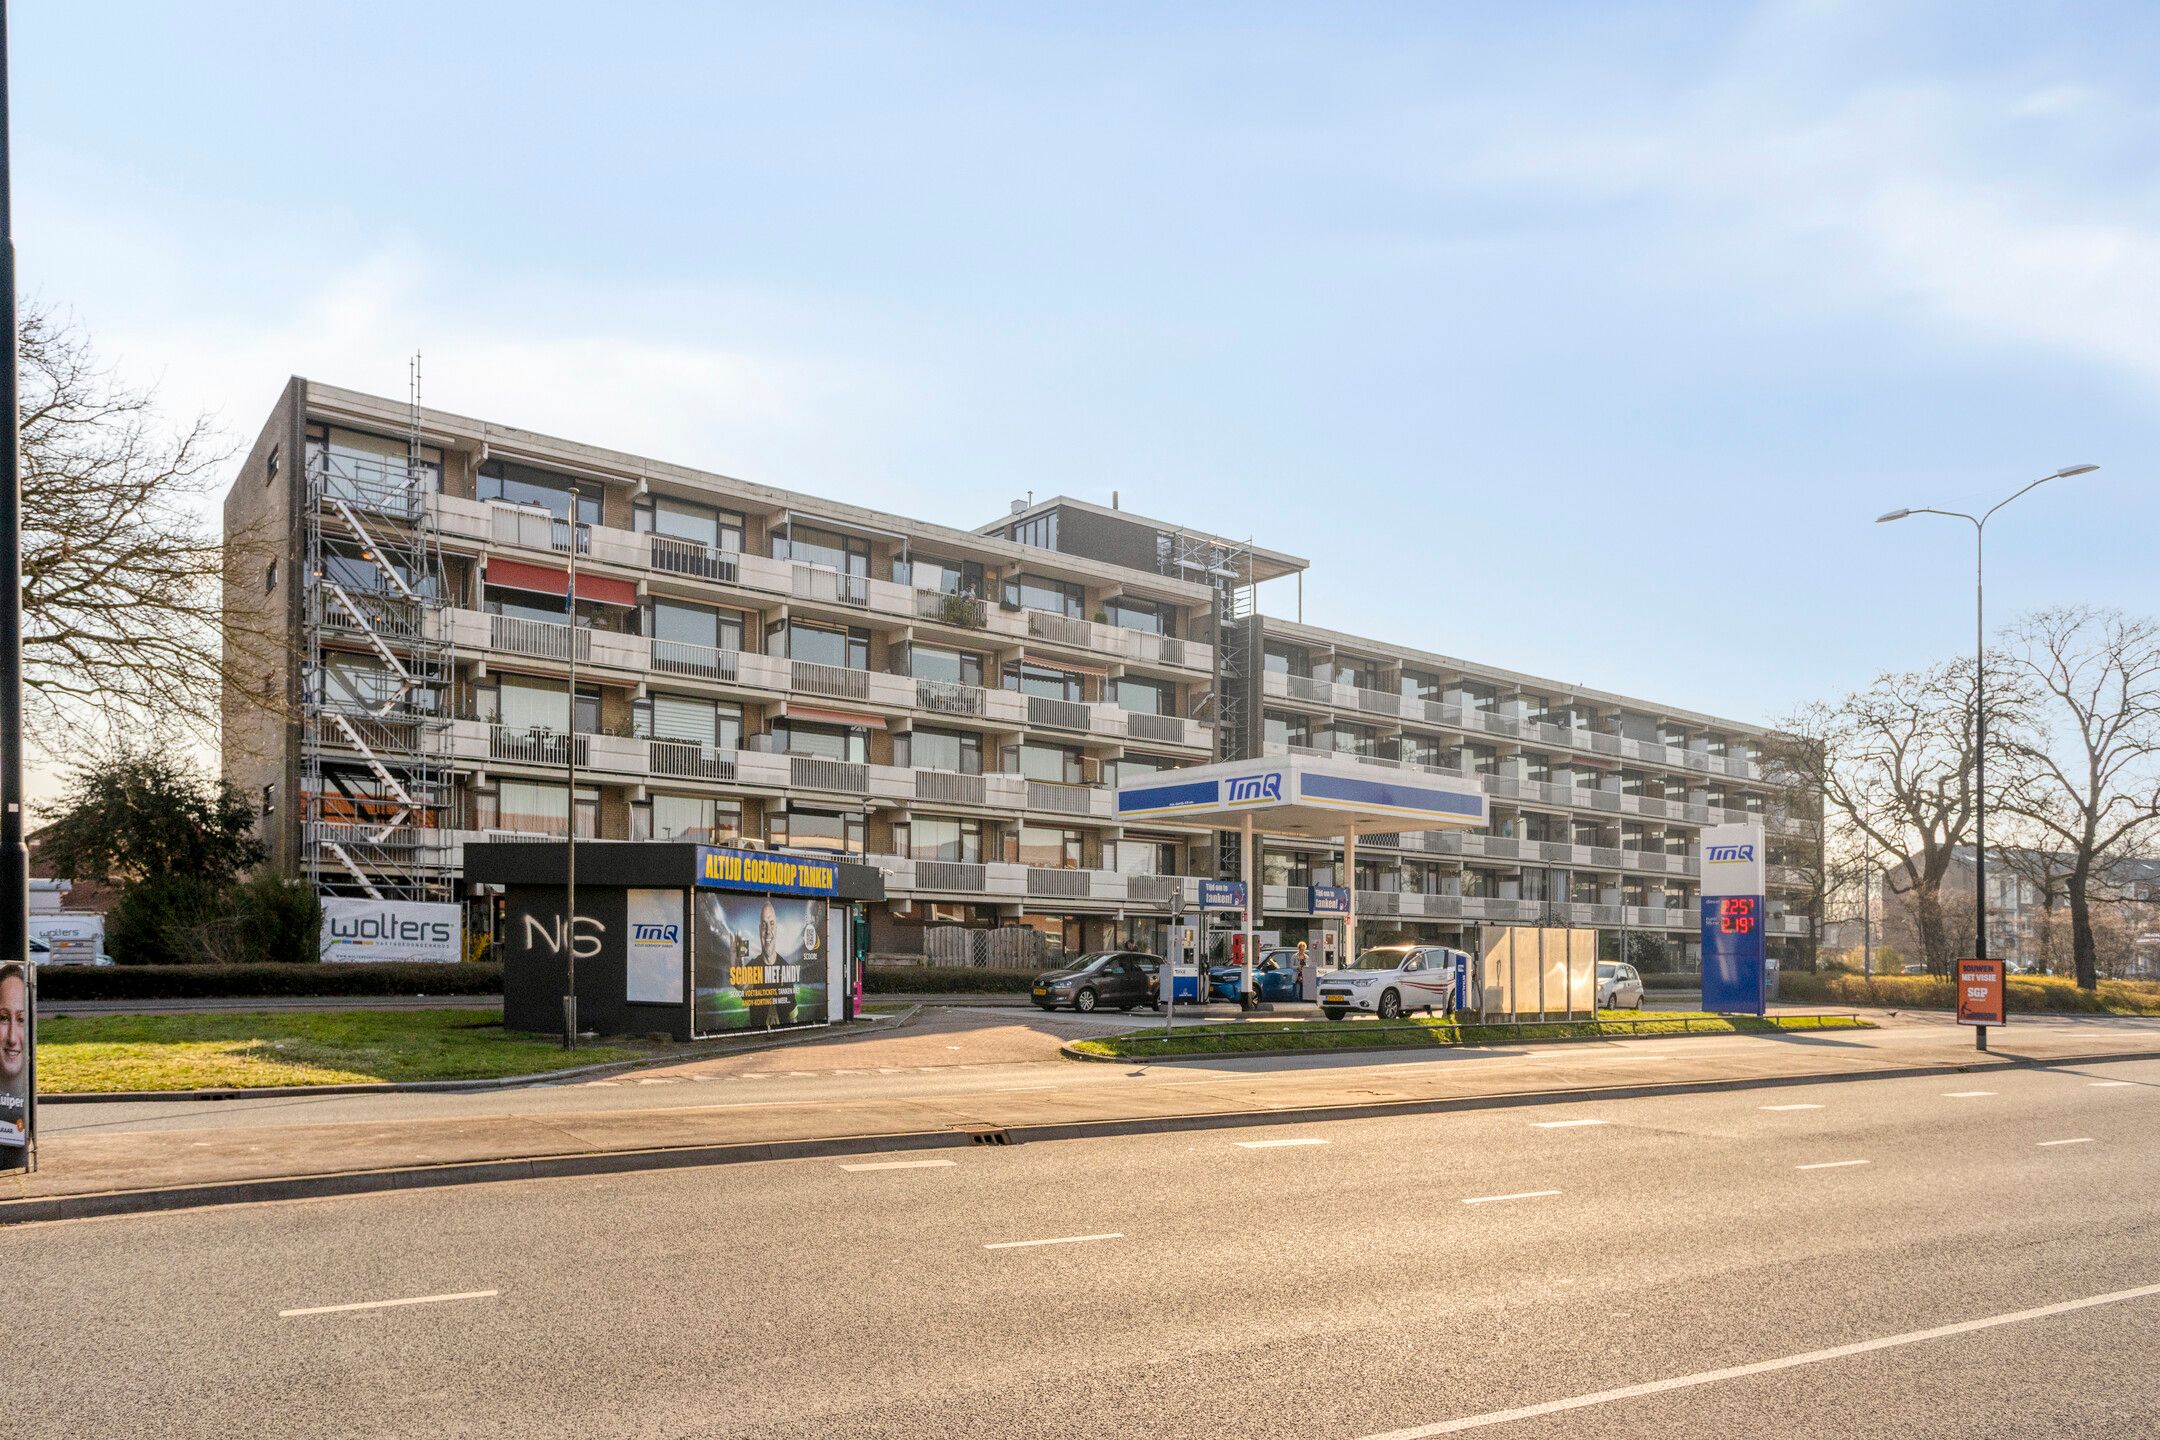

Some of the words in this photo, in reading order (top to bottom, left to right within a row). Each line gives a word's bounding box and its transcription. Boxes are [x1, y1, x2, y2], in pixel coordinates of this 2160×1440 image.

[1225, 773, 1281, 801] TinQ
[1705, 845, 1754, 862] TinQ
[705, 853, 742, 881] ALTIJD
[743, 858, 797, 886] GOEDKOOP
[798, 865, 833, 889] TANKEN
[1205, 892, 1233, 904] tanken!
[1315, 898, 1339, 909] tanken!
[39, 928, 80, 937] wolters
[331, 913, 450, 942] wolters
[632, 924, 678, 944] TinQ
[729, 966, 764, 986] SCOREN
[764, 965, 781, 984] MET
[781, 965, 801, 983] ANDY
[1961, 973, 1975, 981] MET
[1975, 973, 1997, 982] VISIE
[1967, 987, 1989, 998] SGP
